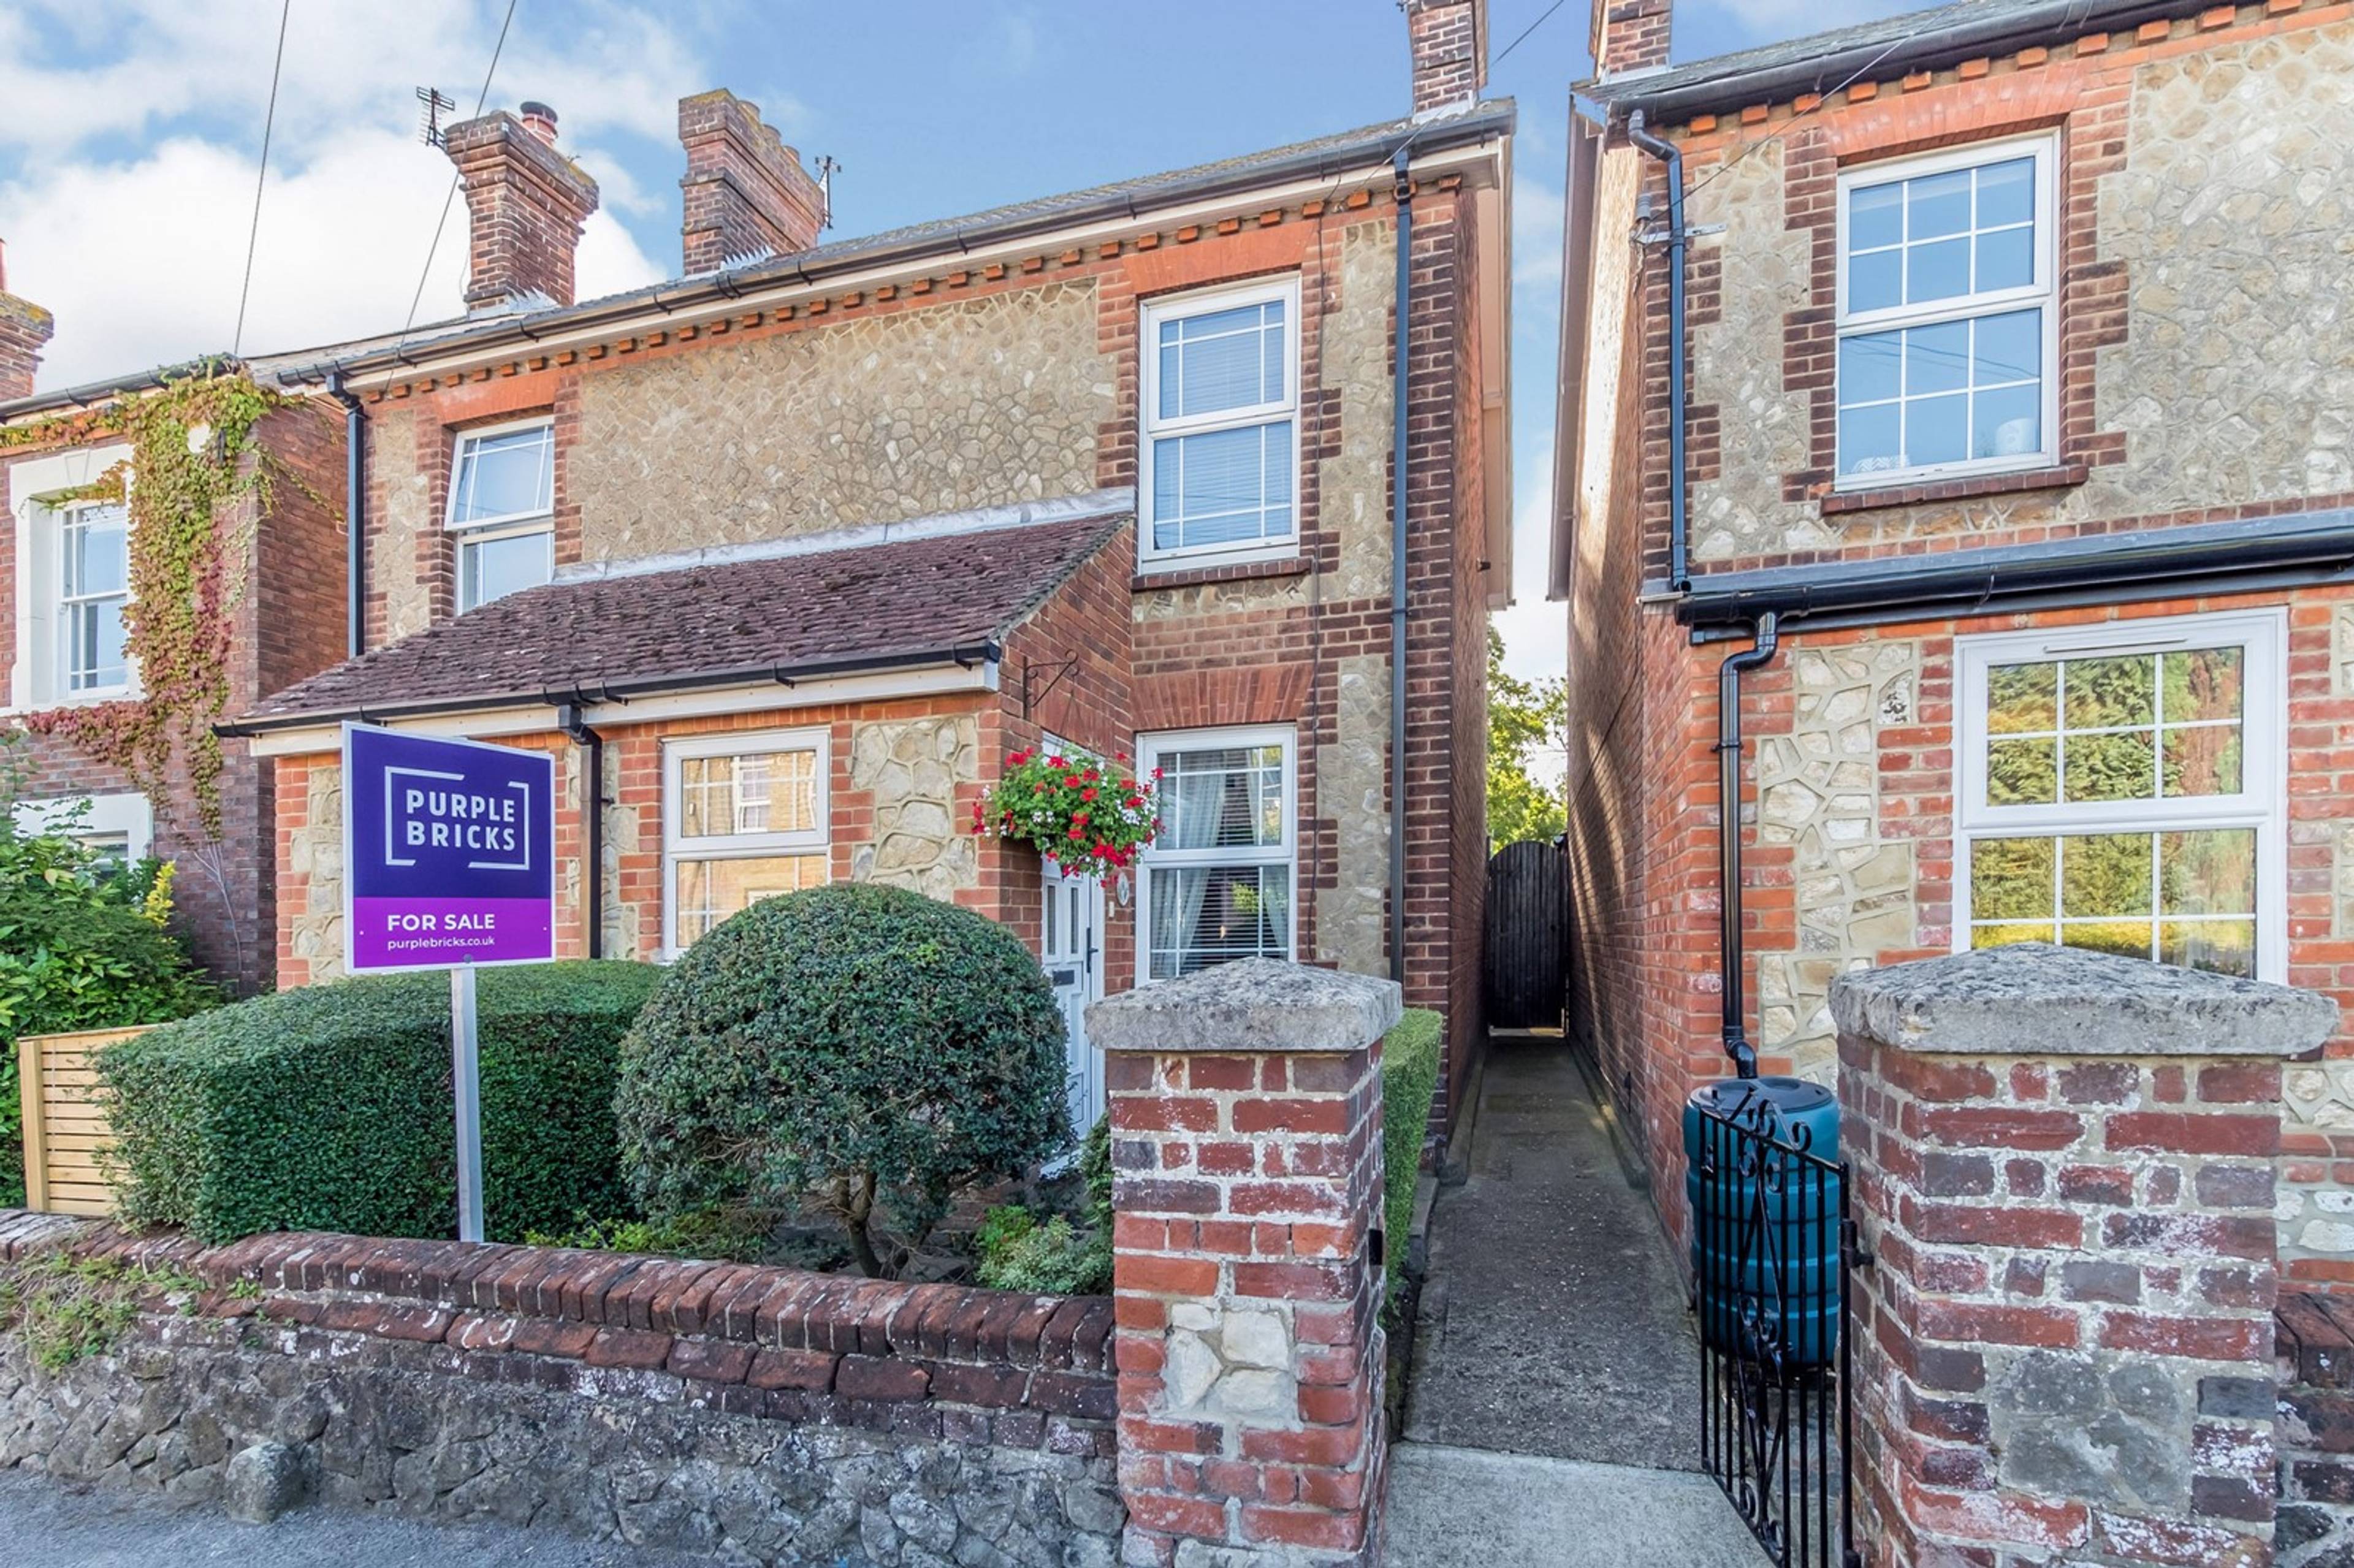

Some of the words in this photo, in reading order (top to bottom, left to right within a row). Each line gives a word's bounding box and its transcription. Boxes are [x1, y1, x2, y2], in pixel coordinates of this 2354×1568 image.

[406, 789, 515, 823] PURPLE
[406, 820, 516, 851] BRICKS
[387, 914, 436, 932] FOR
[443, 913, 495, 931] SALE
[387, 936, 495, 951] purplebricks.co.uk
